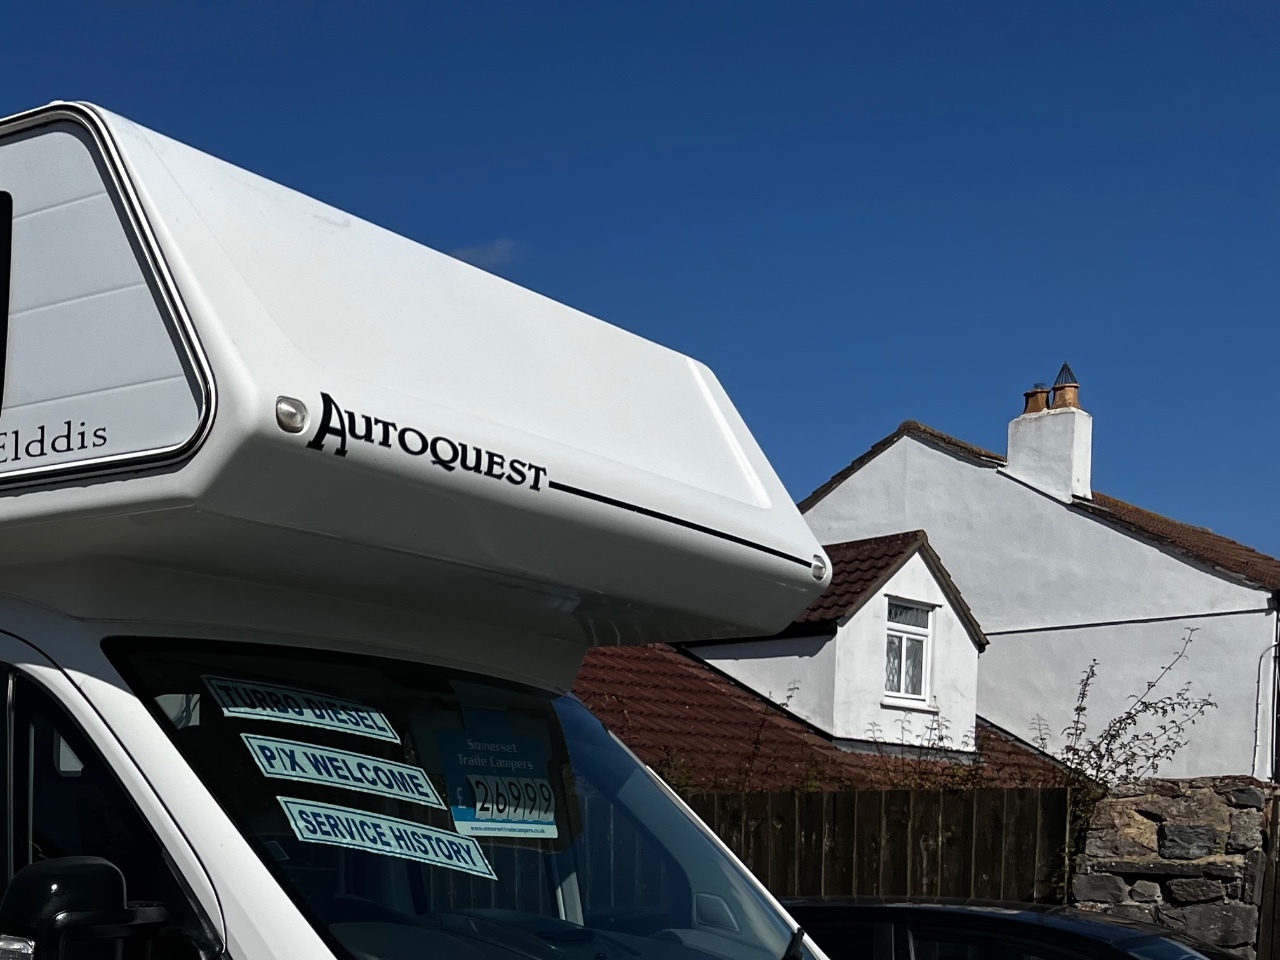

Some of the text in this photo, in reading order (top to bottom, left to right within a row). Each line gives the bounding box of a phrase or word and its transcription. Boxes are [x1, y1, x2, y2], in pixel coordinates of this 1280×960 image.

[306, 391, 547, 492] AUTOQUEST
[216, 684, 388, 733] TURBO DIESEL
[457, 753, 534, 771] Trade Campers
[467, 739, 518, 753] Somerset
[257, 744, 430, 798] P/X WELCOME
[475, 780, 552, 815] 26999
[298, 809, 478, 867] SERVICE HISTORY
